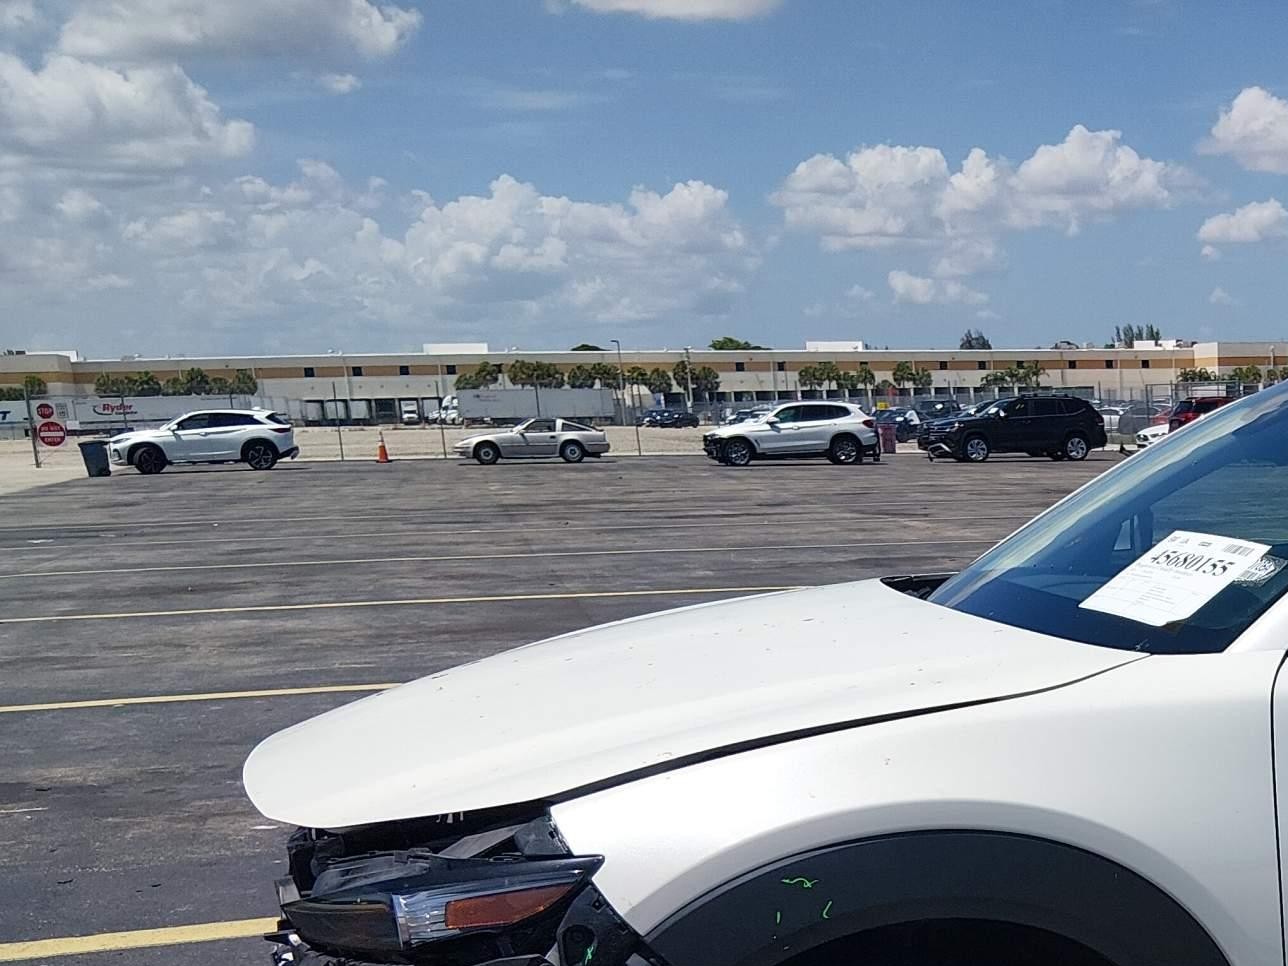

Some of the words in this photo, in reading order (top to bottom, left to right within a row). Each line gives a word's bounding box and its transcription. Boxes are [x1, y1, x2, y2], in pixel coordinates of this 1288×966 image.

[37, 407, 53, 415] STOP
[102, 403, 133, 413] Ryder
[1150, 550, 1236, 576] 45680155
